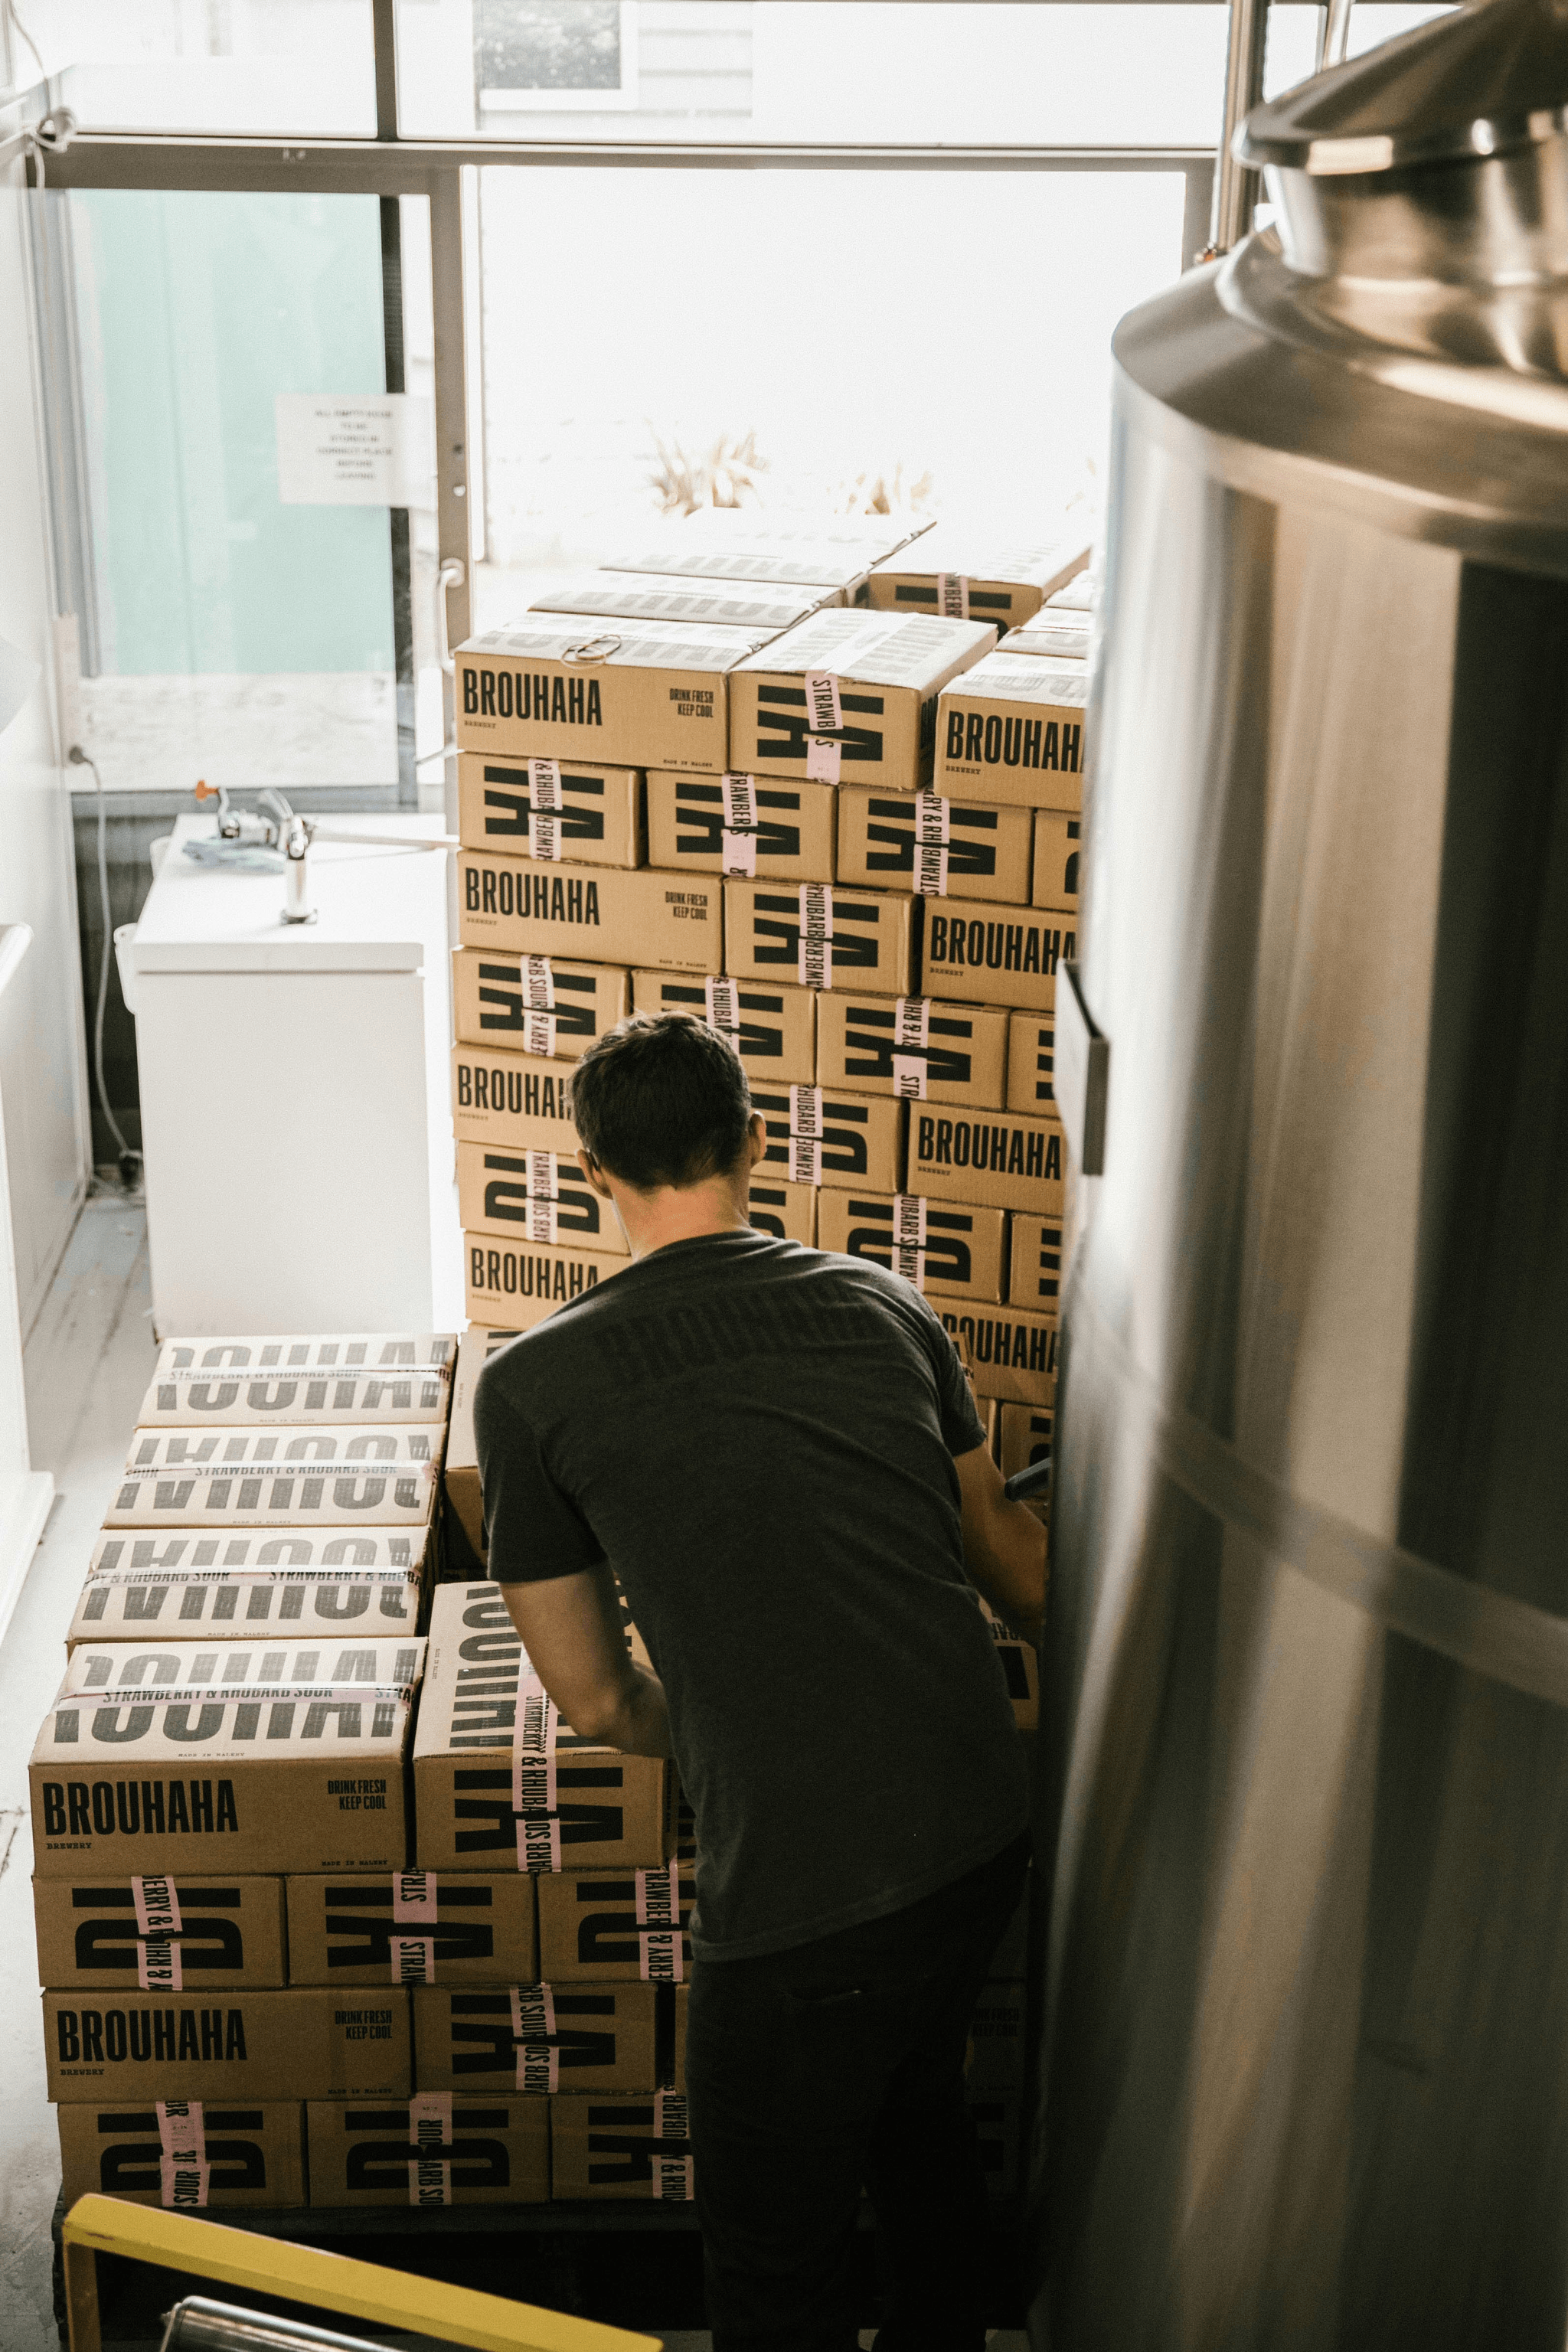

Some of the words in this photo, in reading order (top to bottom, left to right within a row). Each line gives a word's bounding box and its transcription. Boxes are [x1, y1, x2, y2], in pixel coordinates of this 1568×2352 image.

[462, 668, 603, 727] BROUHAHA
[691, 690, 714, 704] FRESH
[677, 703, 695, 717] KEEP
[695, 704, 714, 718] COOL
[946, 710, 1083, 773] BROUHAH
[465, 867, 601, 926] BROUHAHA
[686, 893, 708, 906] FRESH
[673, 905, 689, 919] KEEP
[690, 907, 707, 921] COOL
[918, 1116, 1062, 1181] BROUHAHA
[521, 1756, 547, 1766] &
[327, 1779, 357, 1795] DRINK
[358, 1779, 387, 1794] FRESH
[42, 1779, 239, 1836] BROUHAHA
[339, 1795, 362, 1810] KEEP
[363, 1795, 387, 1810] COOL
[146, 1916, 174, 1927] &
[647, 1933, 673, 1944] &
[146, 1968, 173, 1979] &
[335, 2010, 362, 2025] DRINK
[364, 2009, 393, 2024] FRESH
[56, 2009, 248, 2063] BROUHAHA
[345, 2025, 368, 2040] KEEP
[369, 2024, 393, 2040] COOL
[60, 2068, 105, 2076] BREWERY
